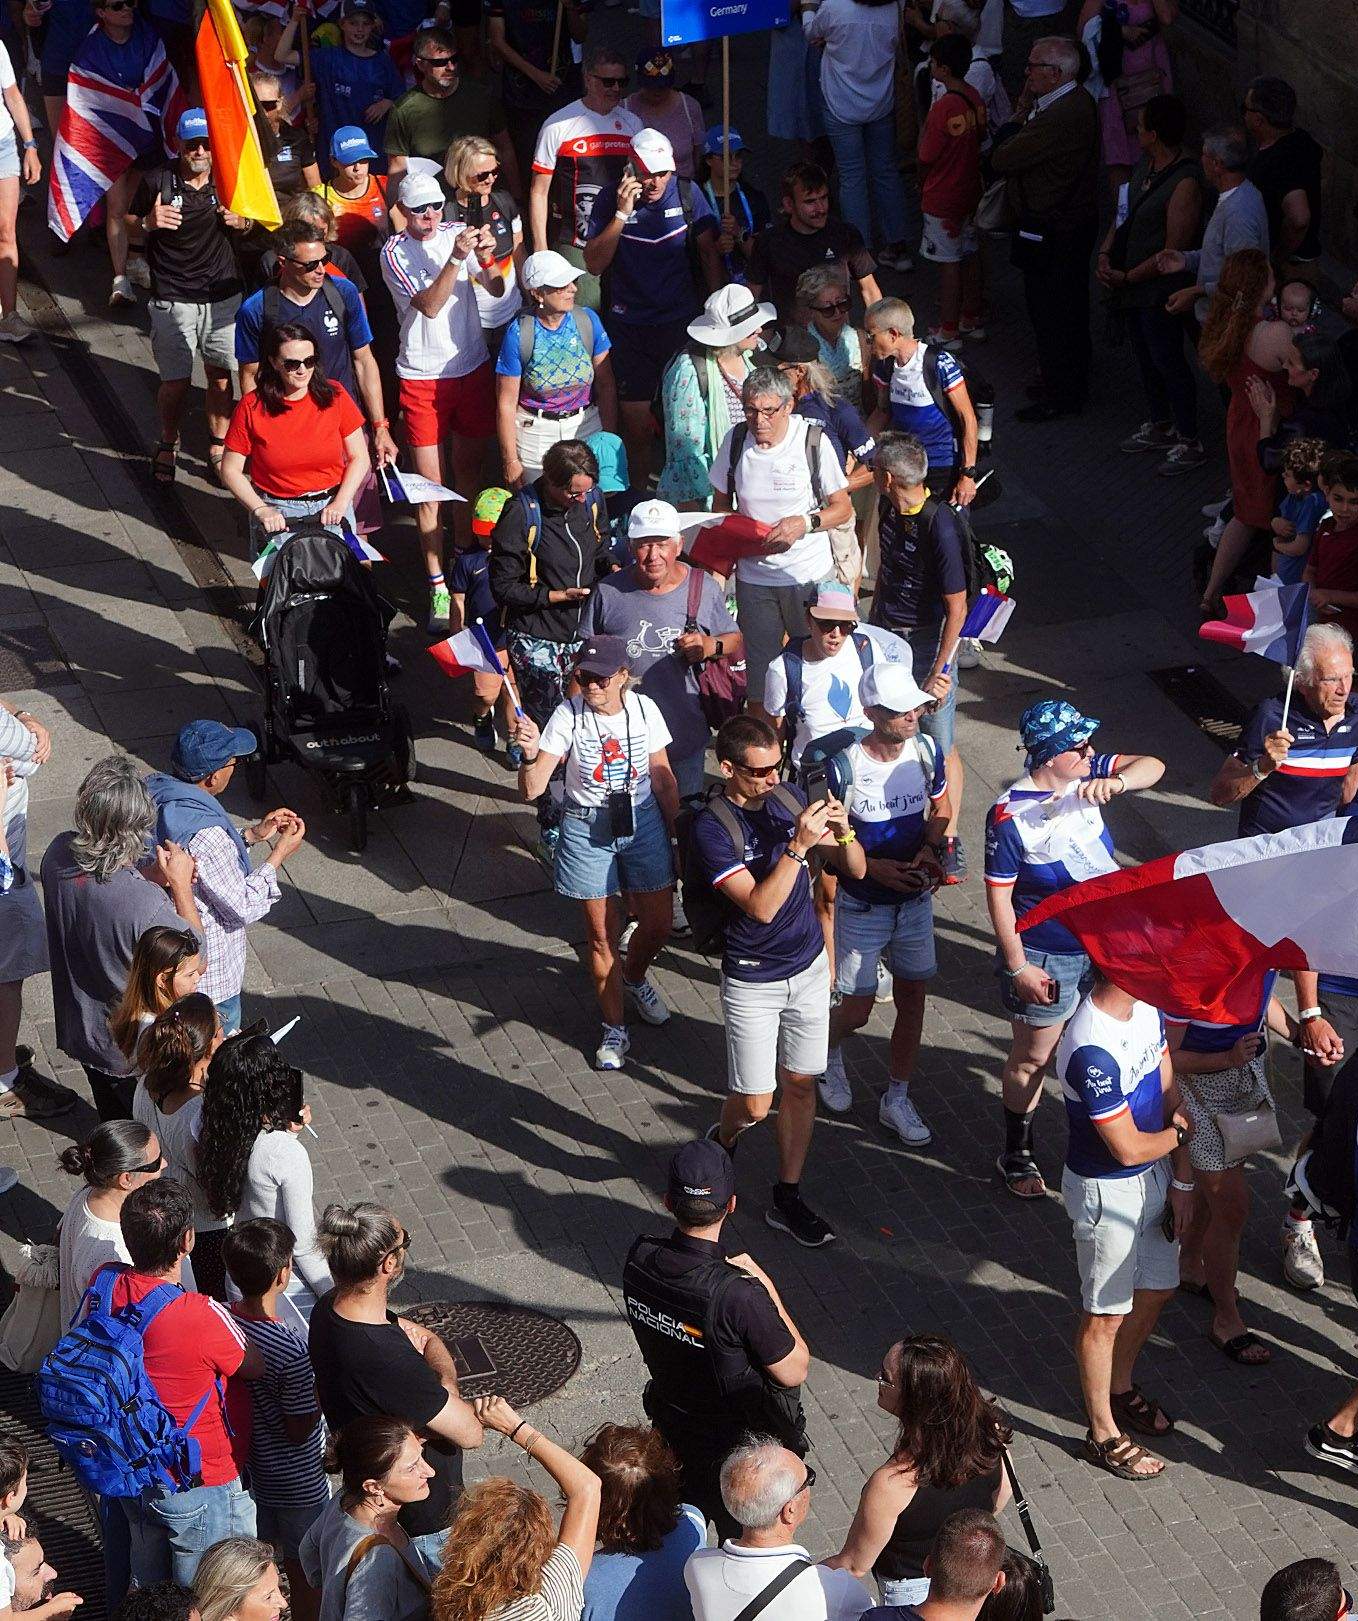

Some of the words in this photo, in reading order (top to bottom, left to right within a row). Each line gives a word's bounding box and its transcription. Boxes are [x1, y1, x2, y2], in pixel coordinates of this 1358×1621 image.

[709, 3, 748, 17] Germany
[859, 799, 876, 813] Au
[879, 796, 900, 811] bout
[627, 1295, 686, 1333] POLICIA
[628, 1306, 705, 1349] NACIONAL
